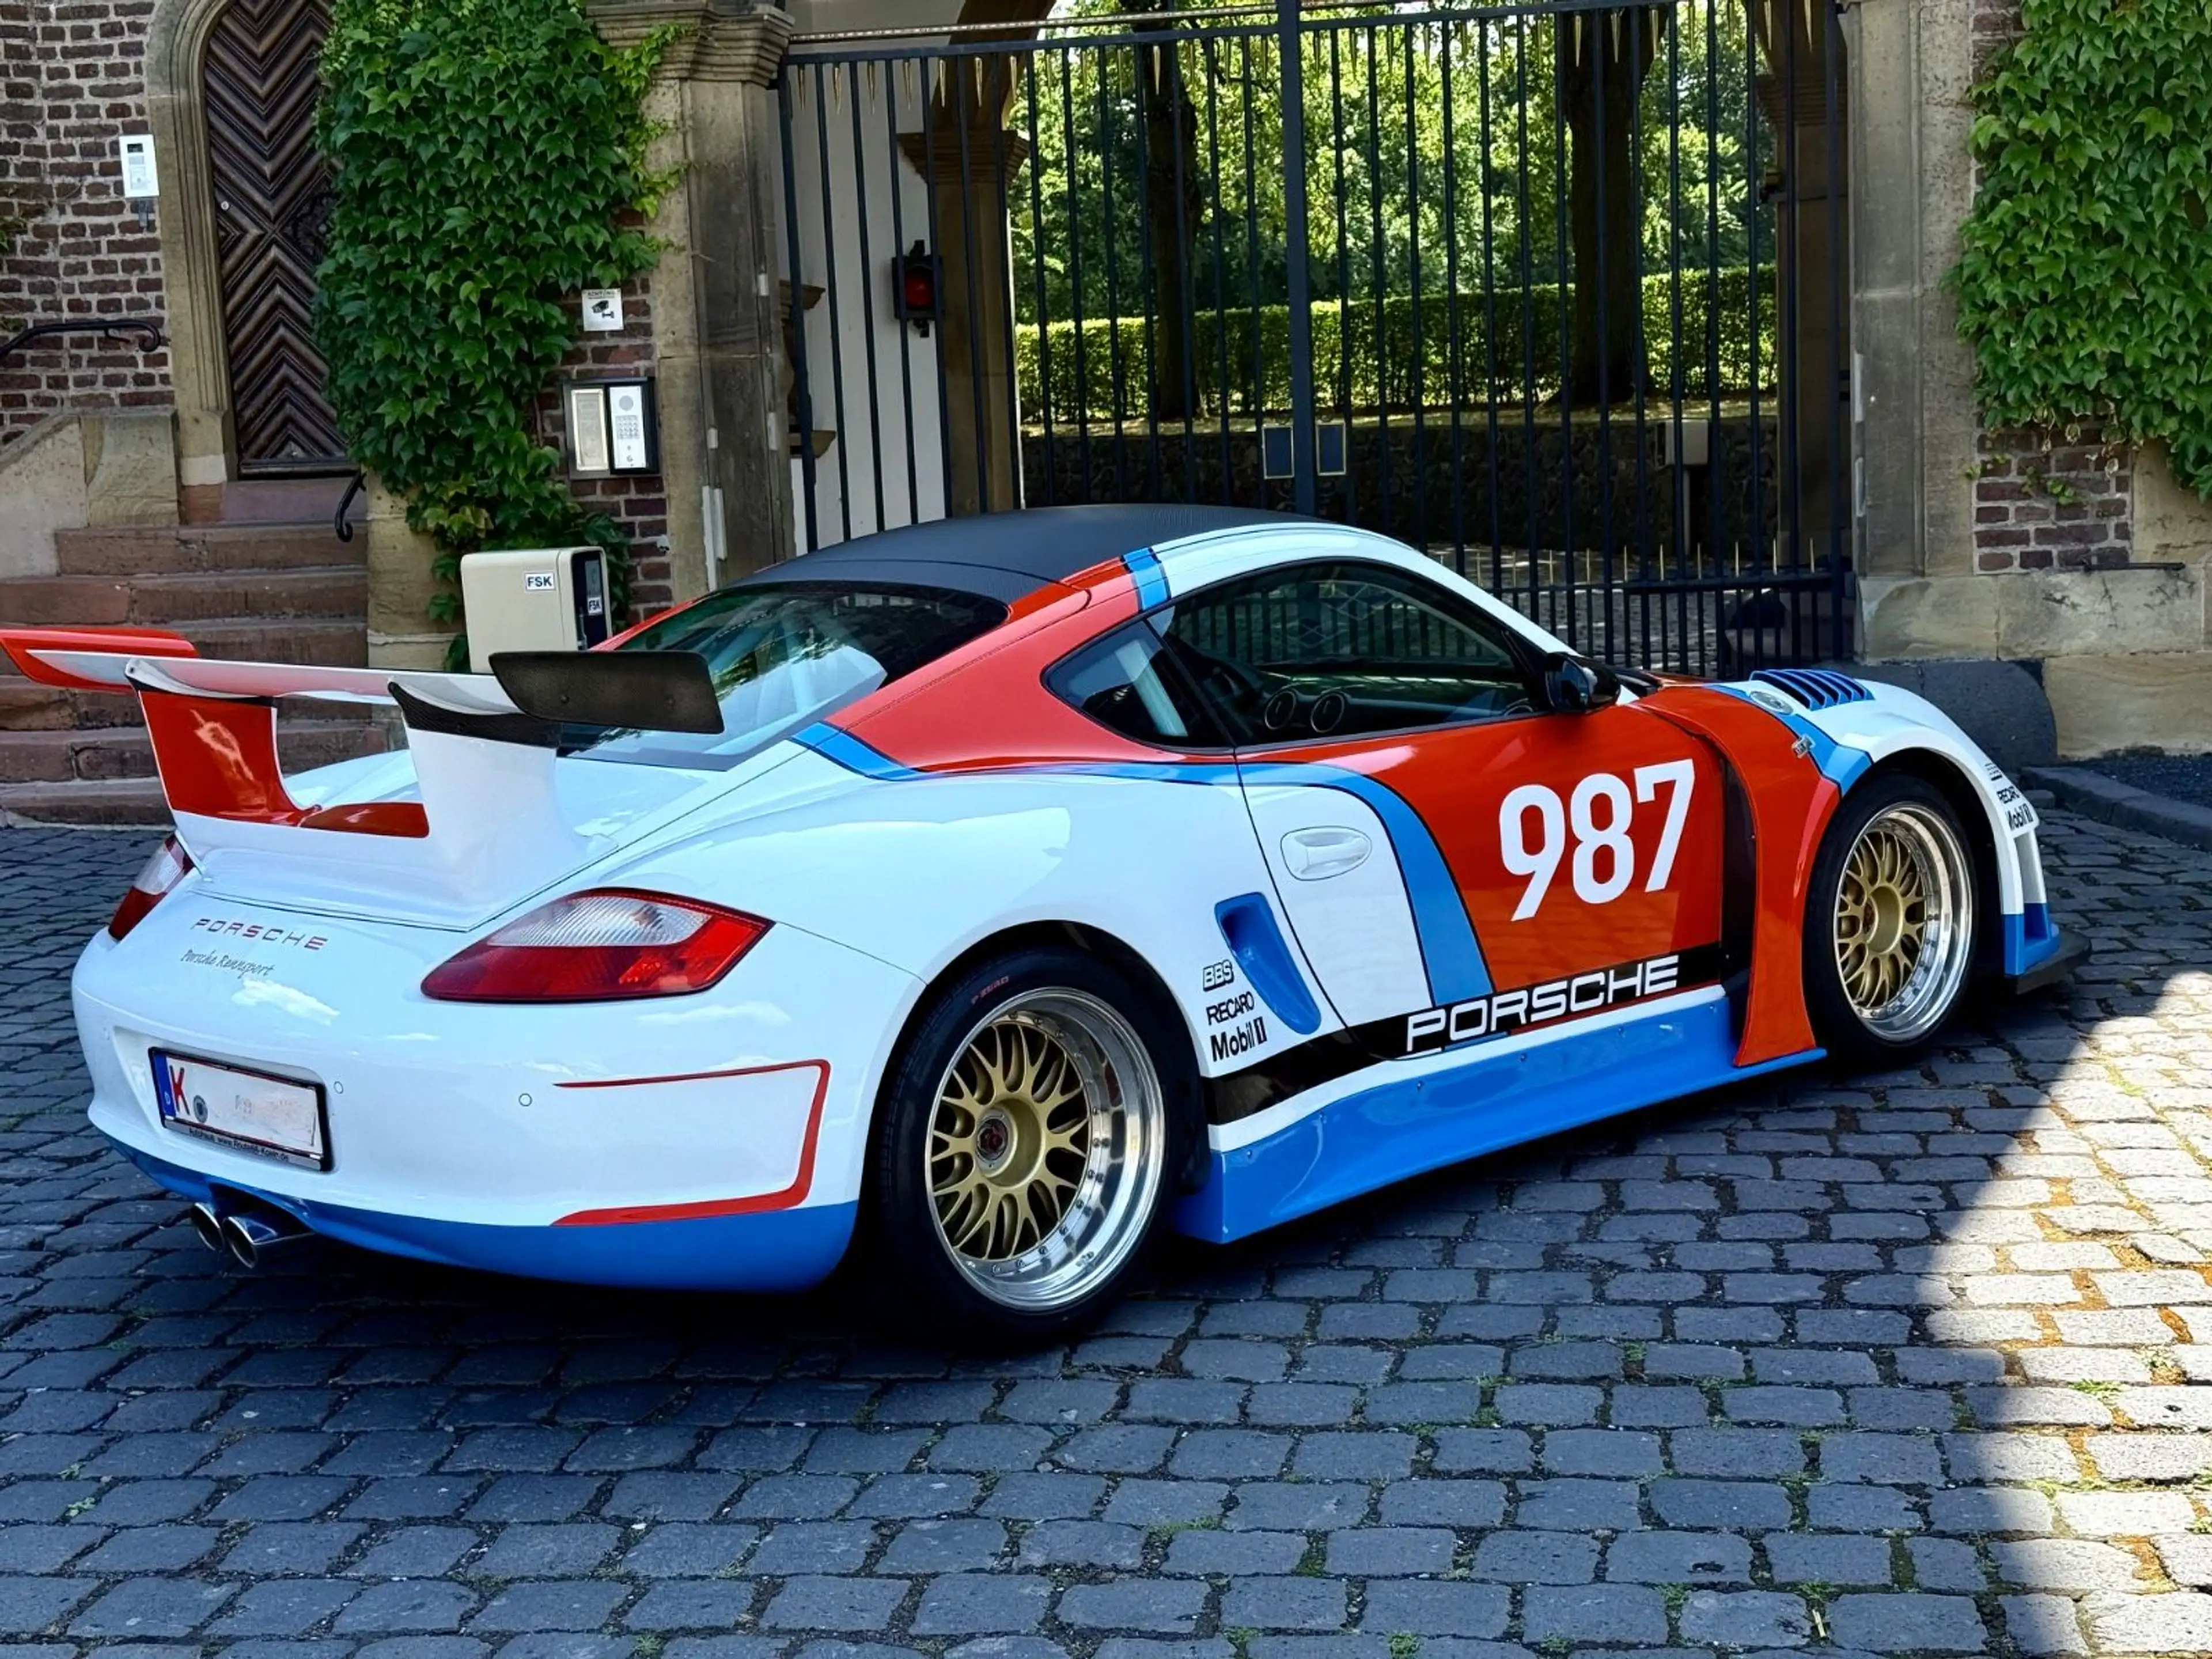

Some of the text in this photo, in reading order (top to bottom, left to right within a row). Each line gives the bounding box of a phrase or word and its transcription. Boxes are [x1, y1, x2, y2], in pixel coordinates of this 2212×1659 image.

[527, 576, 552, 587] FSK
[1499, 758, 1695, 922] 987
[190, 918, 329, 950] PORSCHE
[180, 948, 275, 979] Porsche Rennsport
[1202, 959, 1234, 992] BBS
[1206, 990, 1255, 1026] RECARO
[1407, 955, 1679, 1051] PORSCHE
[1210, 1020, 1256, 1062] Mobil
[170, 1065, 190, 1116] K
